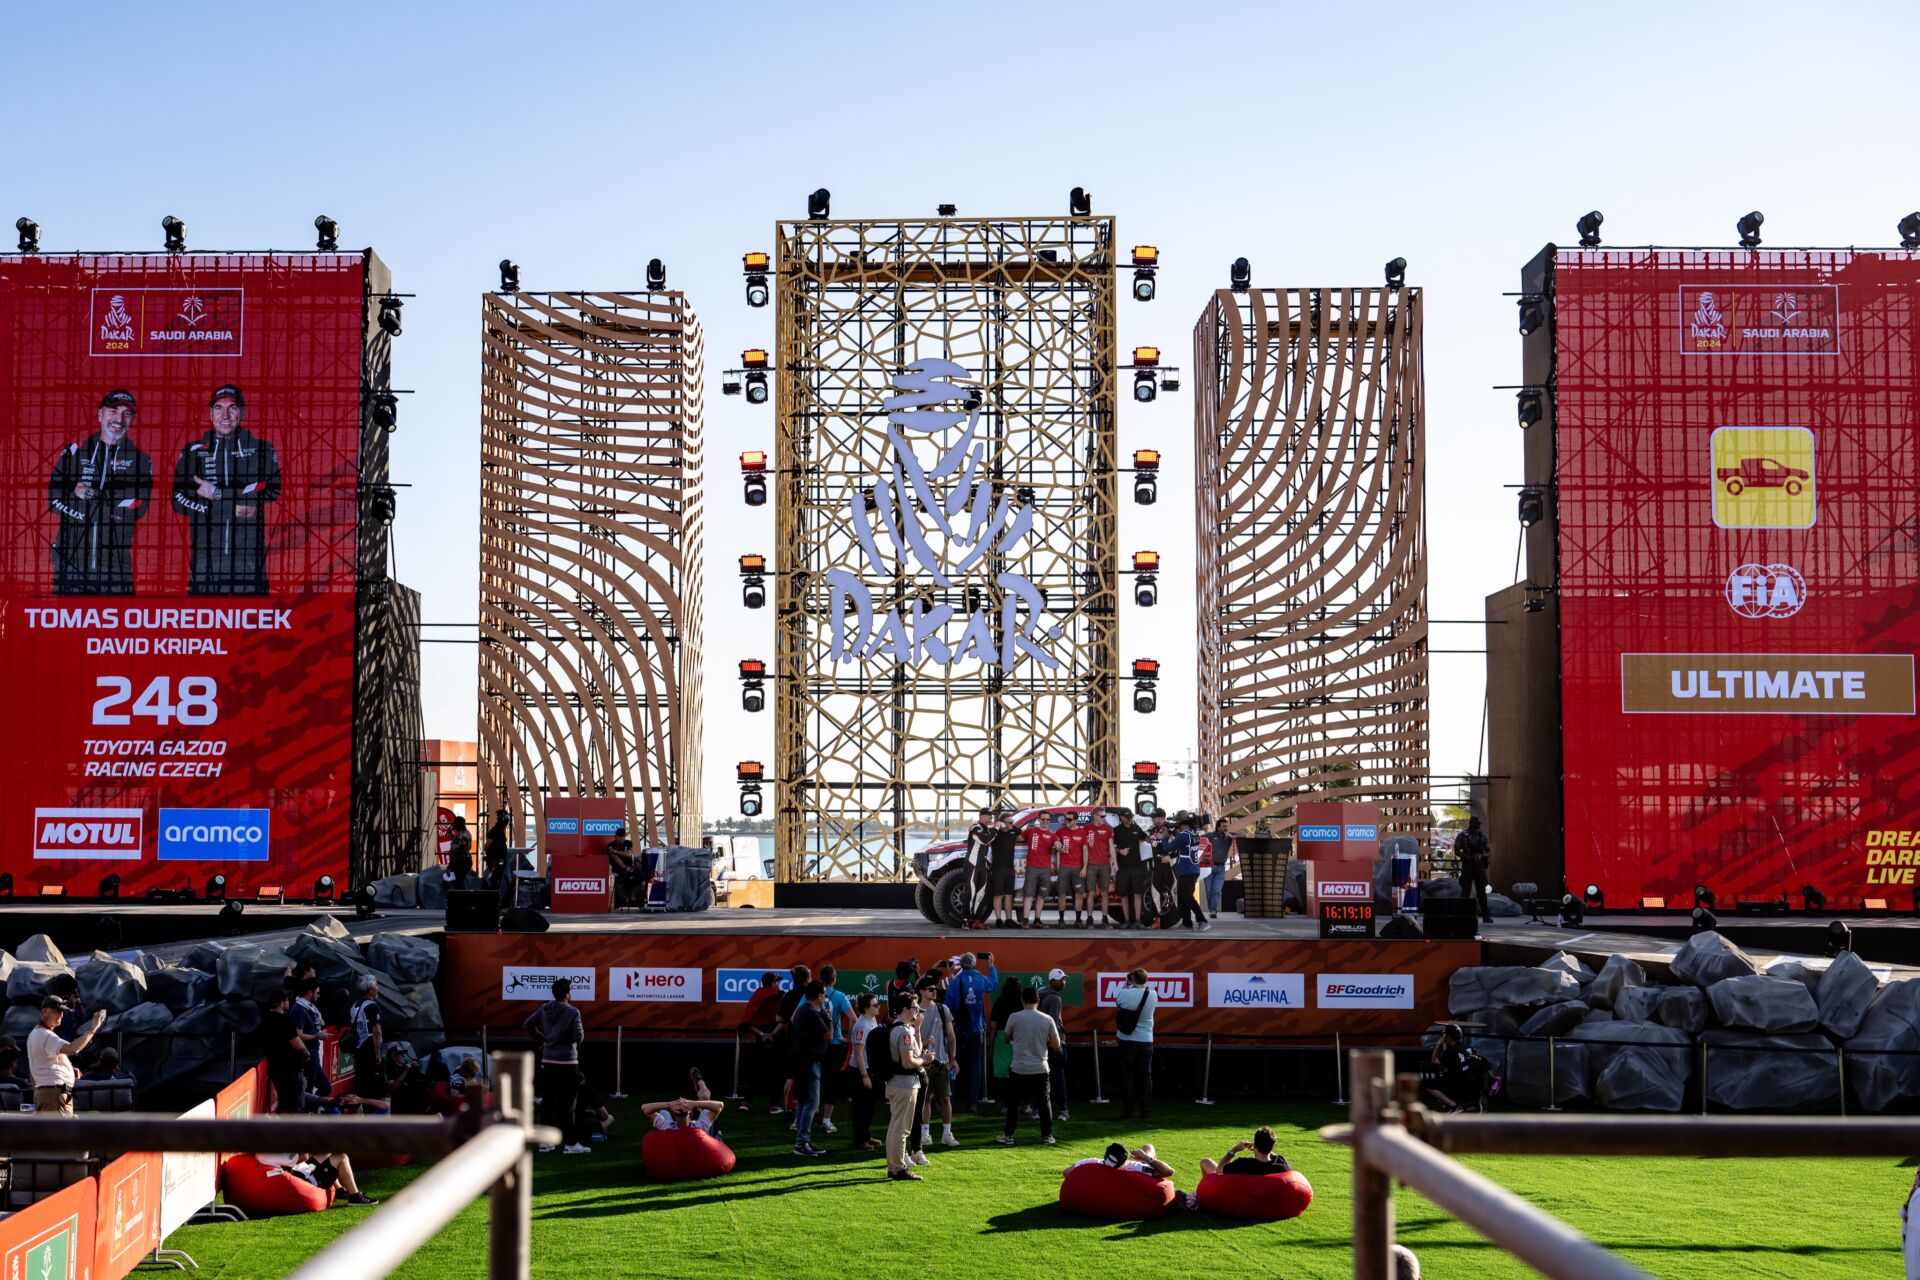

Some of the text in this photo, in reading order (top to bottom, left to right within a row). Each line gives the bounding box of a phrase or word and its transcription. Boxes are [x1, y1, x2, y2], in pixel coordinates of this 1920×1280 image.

[101, 325, 135, 341] DAKAR
[150, 331, 233, 340] SAUDI ARABIA
[1691, 323, 1726, 339] DAKAR
[1743, 328, 1829, 338] SAUDI ARABIA
[52, 499, 85, 520] HILUX
[175, 493, 208, 513] HILUX
[24, 608, 292, 629] TOMAS OUREDNICEK
[826, 568, 1059, 673] DAKAR
[86, 637, 228, 655] DAVID KRIPAL
[1671, 670, 1866, 699] ULTIMATE
[92, 676, 218, 726] 248
[83, 740, 227, 756] TOYOTA GAZOO
[84, 761, 223, 777] RACING CZECH
[40, 822, 136, 844] MOTUL
[165, 825, 262, 843] aramco
[549, 821, 577, 831] aramco
[585, 822, 621, 832] aramco
[1302, 828, 1338, 838] aramco
[1347, 828, 1375, 837] aramco
[1867, 868, 1917, 885] LIVE
[560, 881, 600, 891] MOTUL
[1323, 885, 1364, 895] MOTUL
[1325, 906, 1372, 919] 16:19:18
[521, 975, 591, 984] REBELION
[1105, 981, 1186, 999] MTUL
[1223, 989, 1289, 1005] AQUAFINA
[1326, 984, 1405, 996] BFGoodrich
